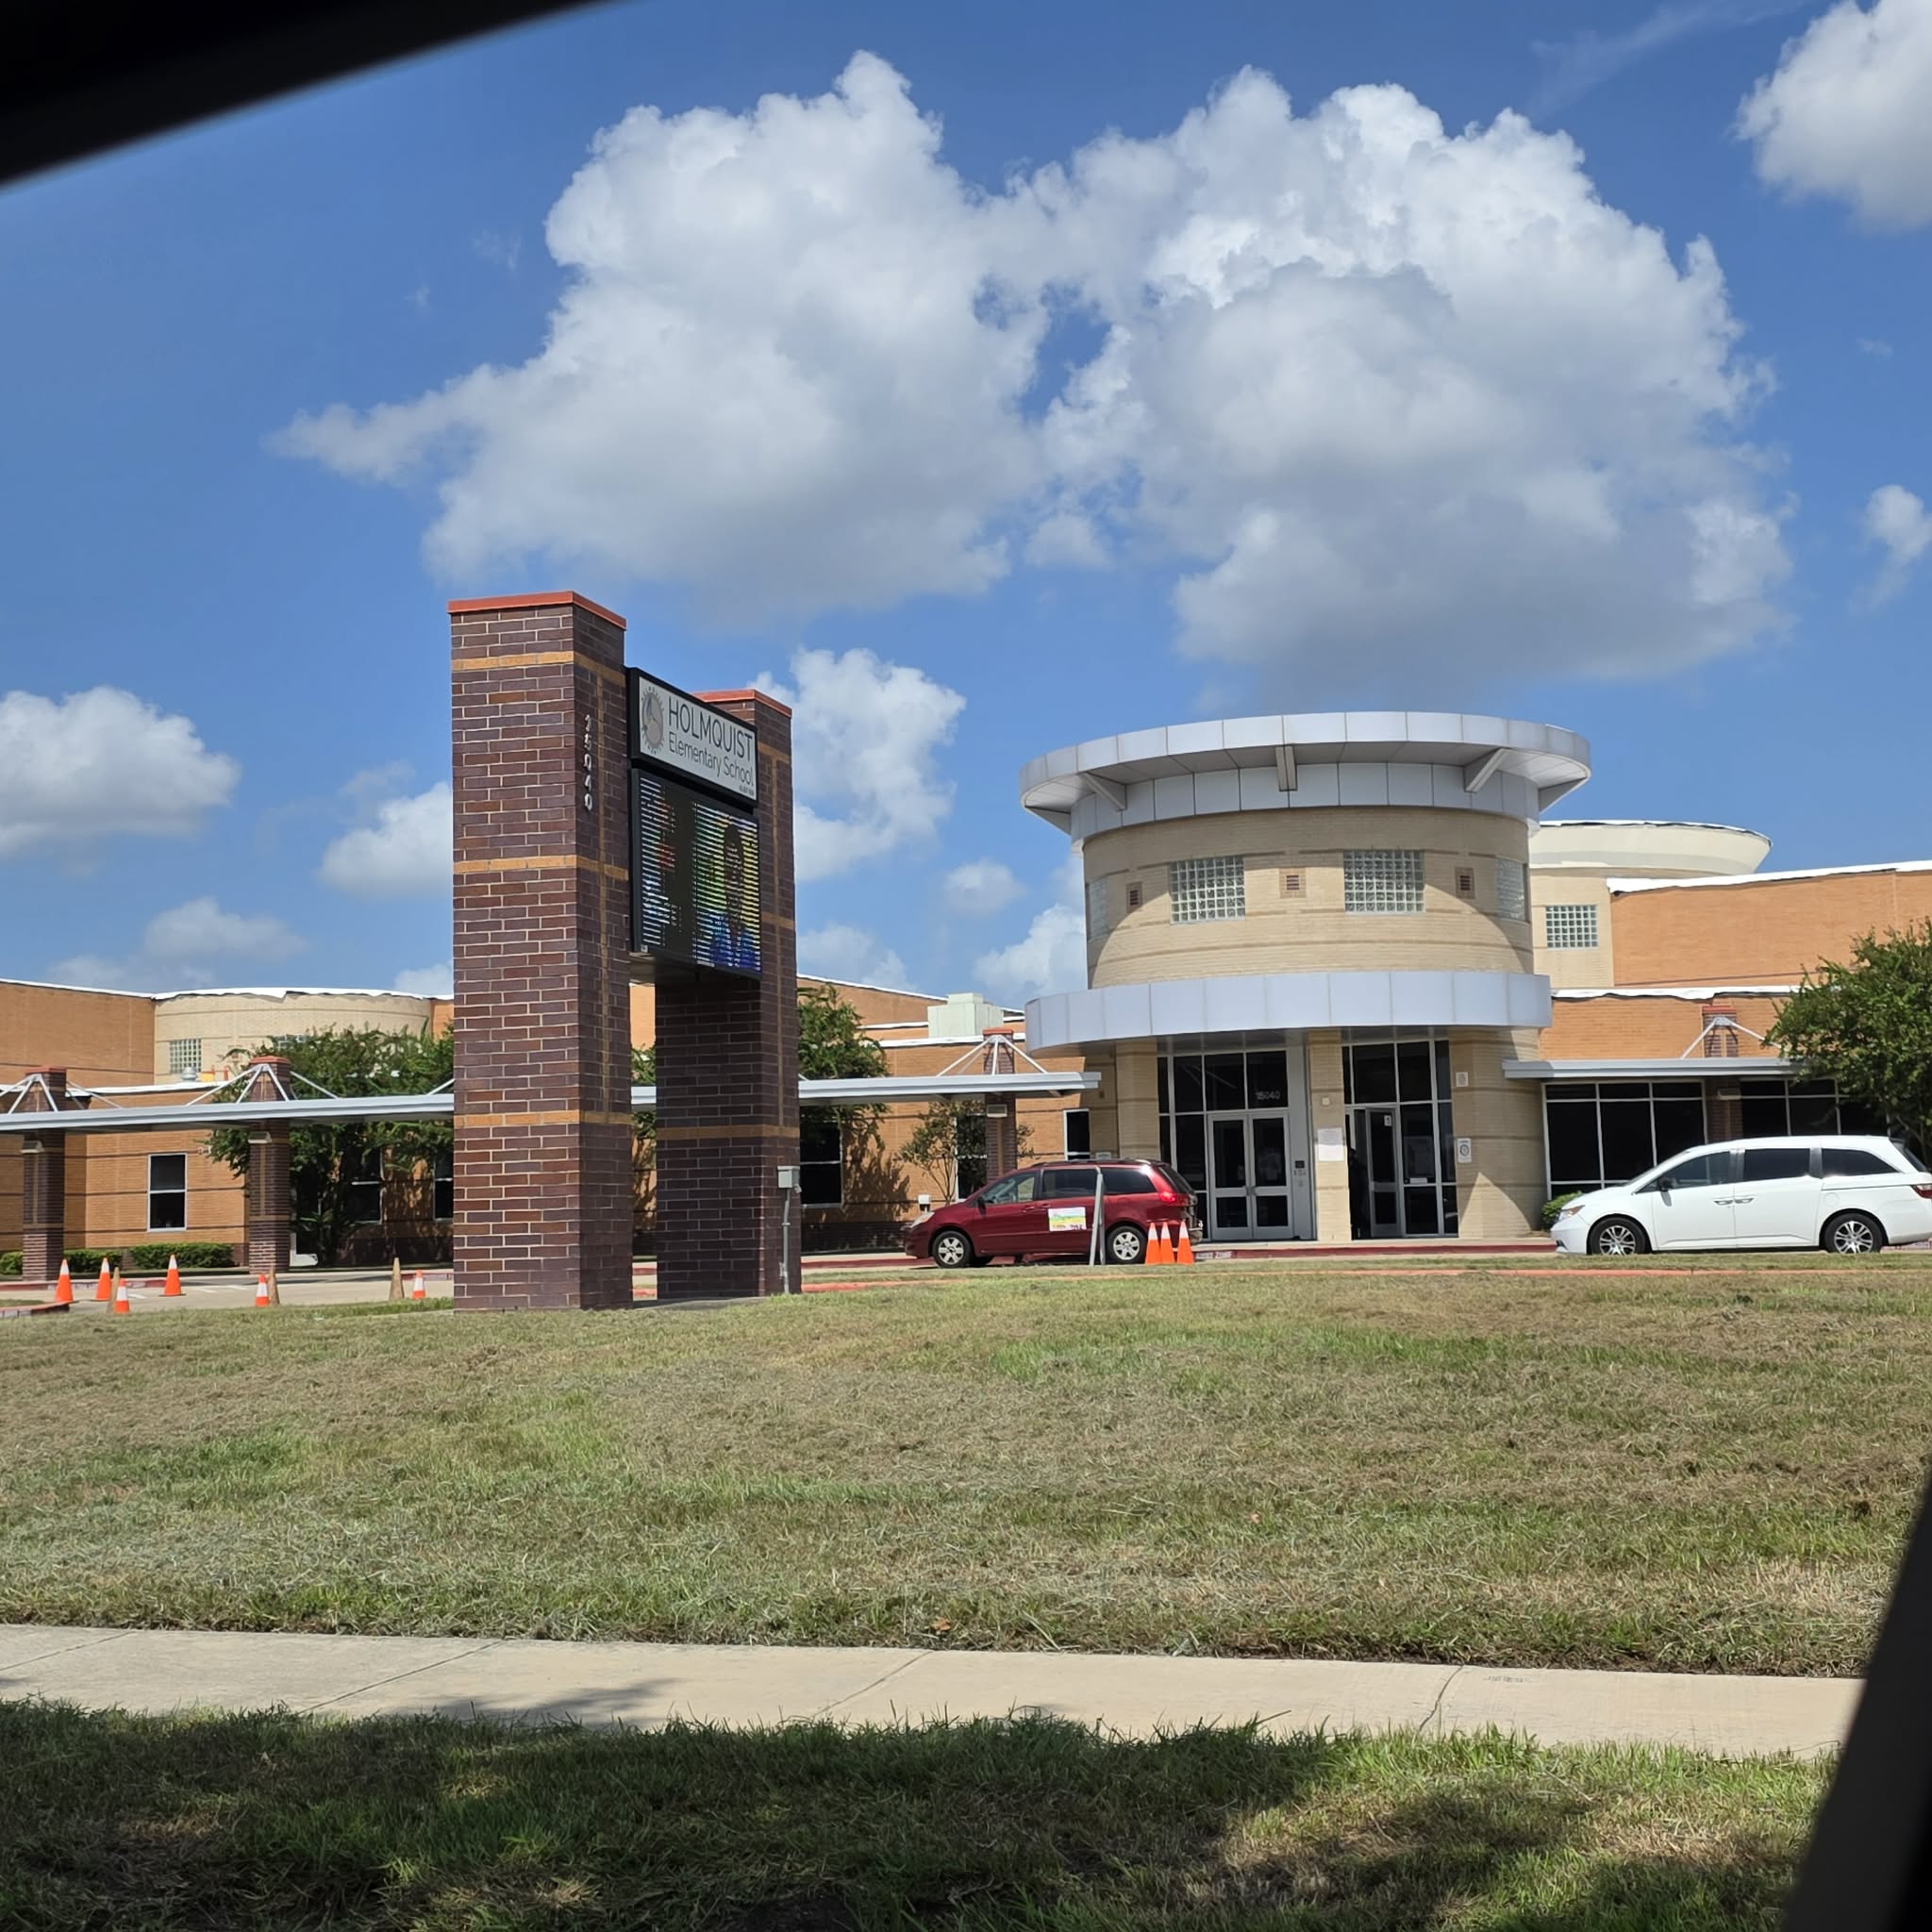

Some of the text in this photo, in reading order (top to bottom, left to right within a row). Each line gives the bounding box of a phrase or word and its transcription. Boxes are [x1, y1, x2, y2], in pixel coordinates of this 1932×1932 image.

[668, 696, 753, 762] HOLMQUIST
[668, 731, 754, 787] Elementary School
[583, 713, 593, 812] 15040
